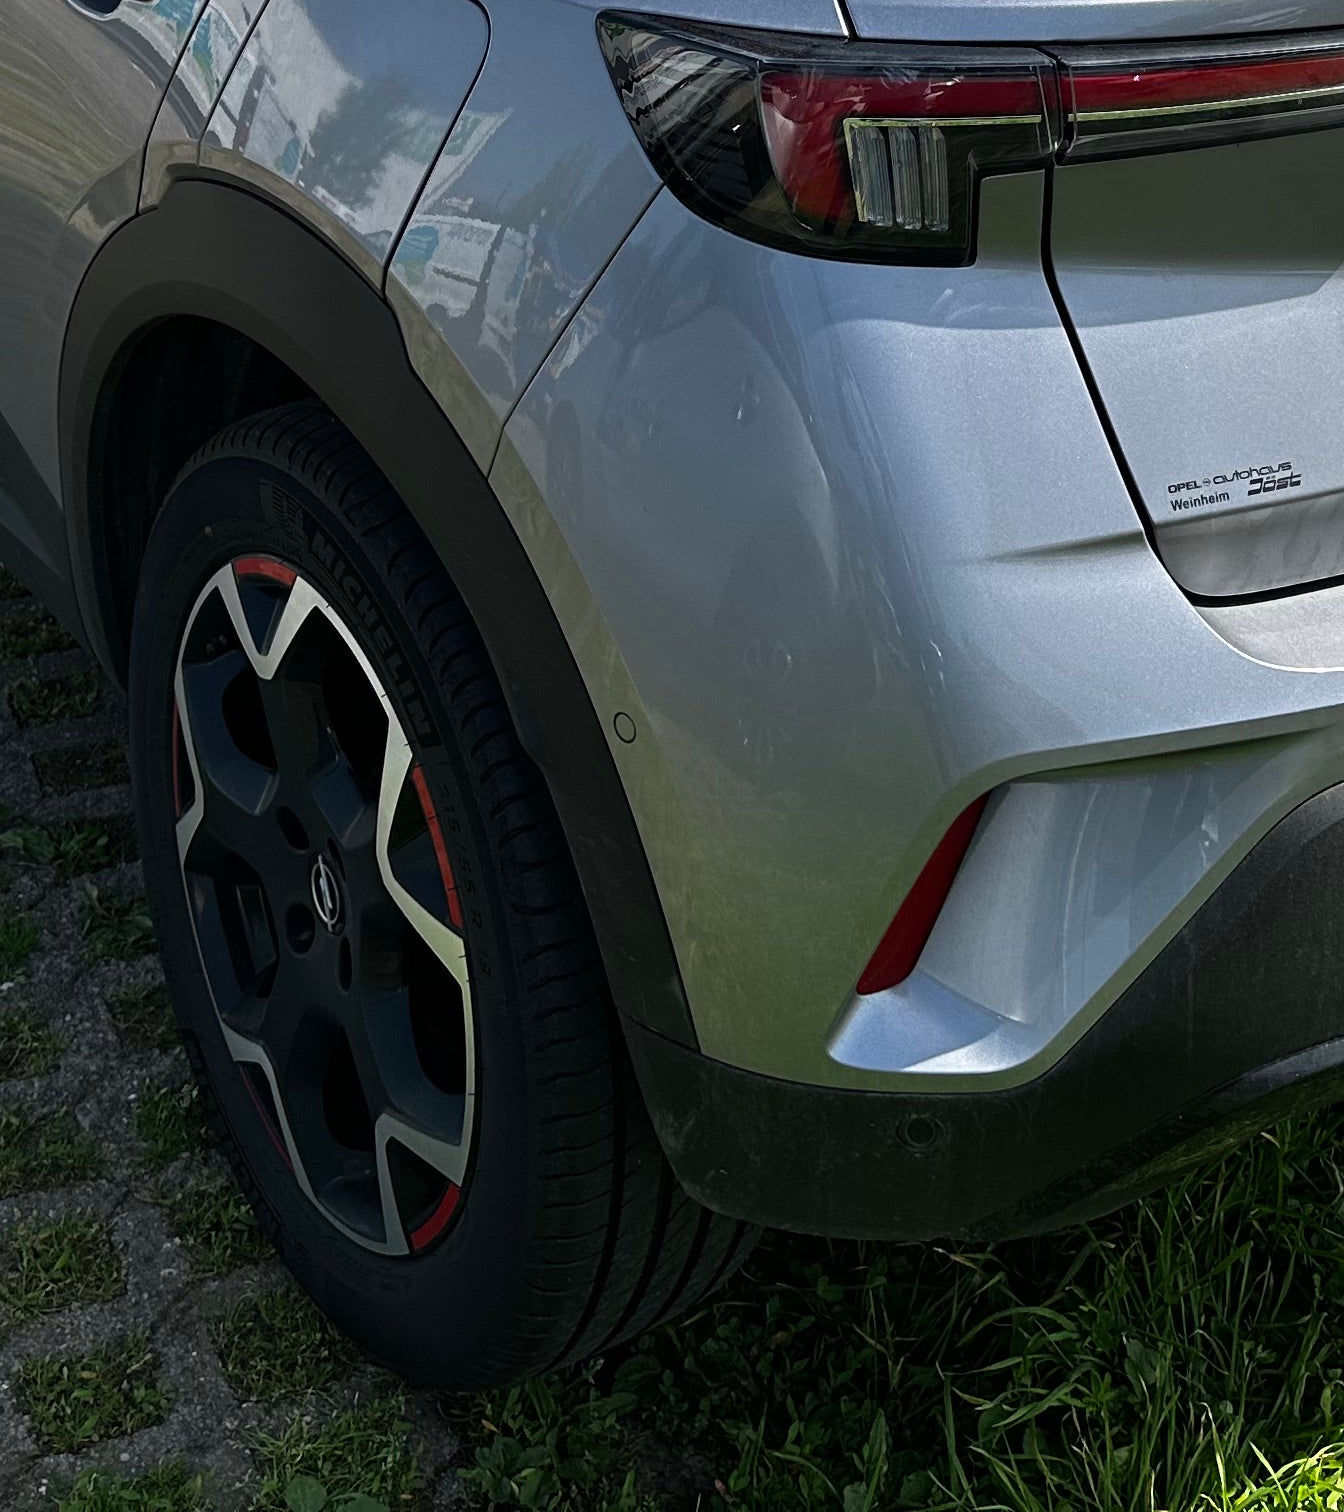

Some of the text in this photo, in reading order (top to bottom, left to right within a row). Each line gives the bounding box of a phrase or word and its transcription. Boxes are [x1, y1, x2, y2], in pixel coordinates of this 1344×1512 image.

[1167, 461, 1293, 494] OPEL autohaus
[1170, 490, 1230, 512] Weinheim
